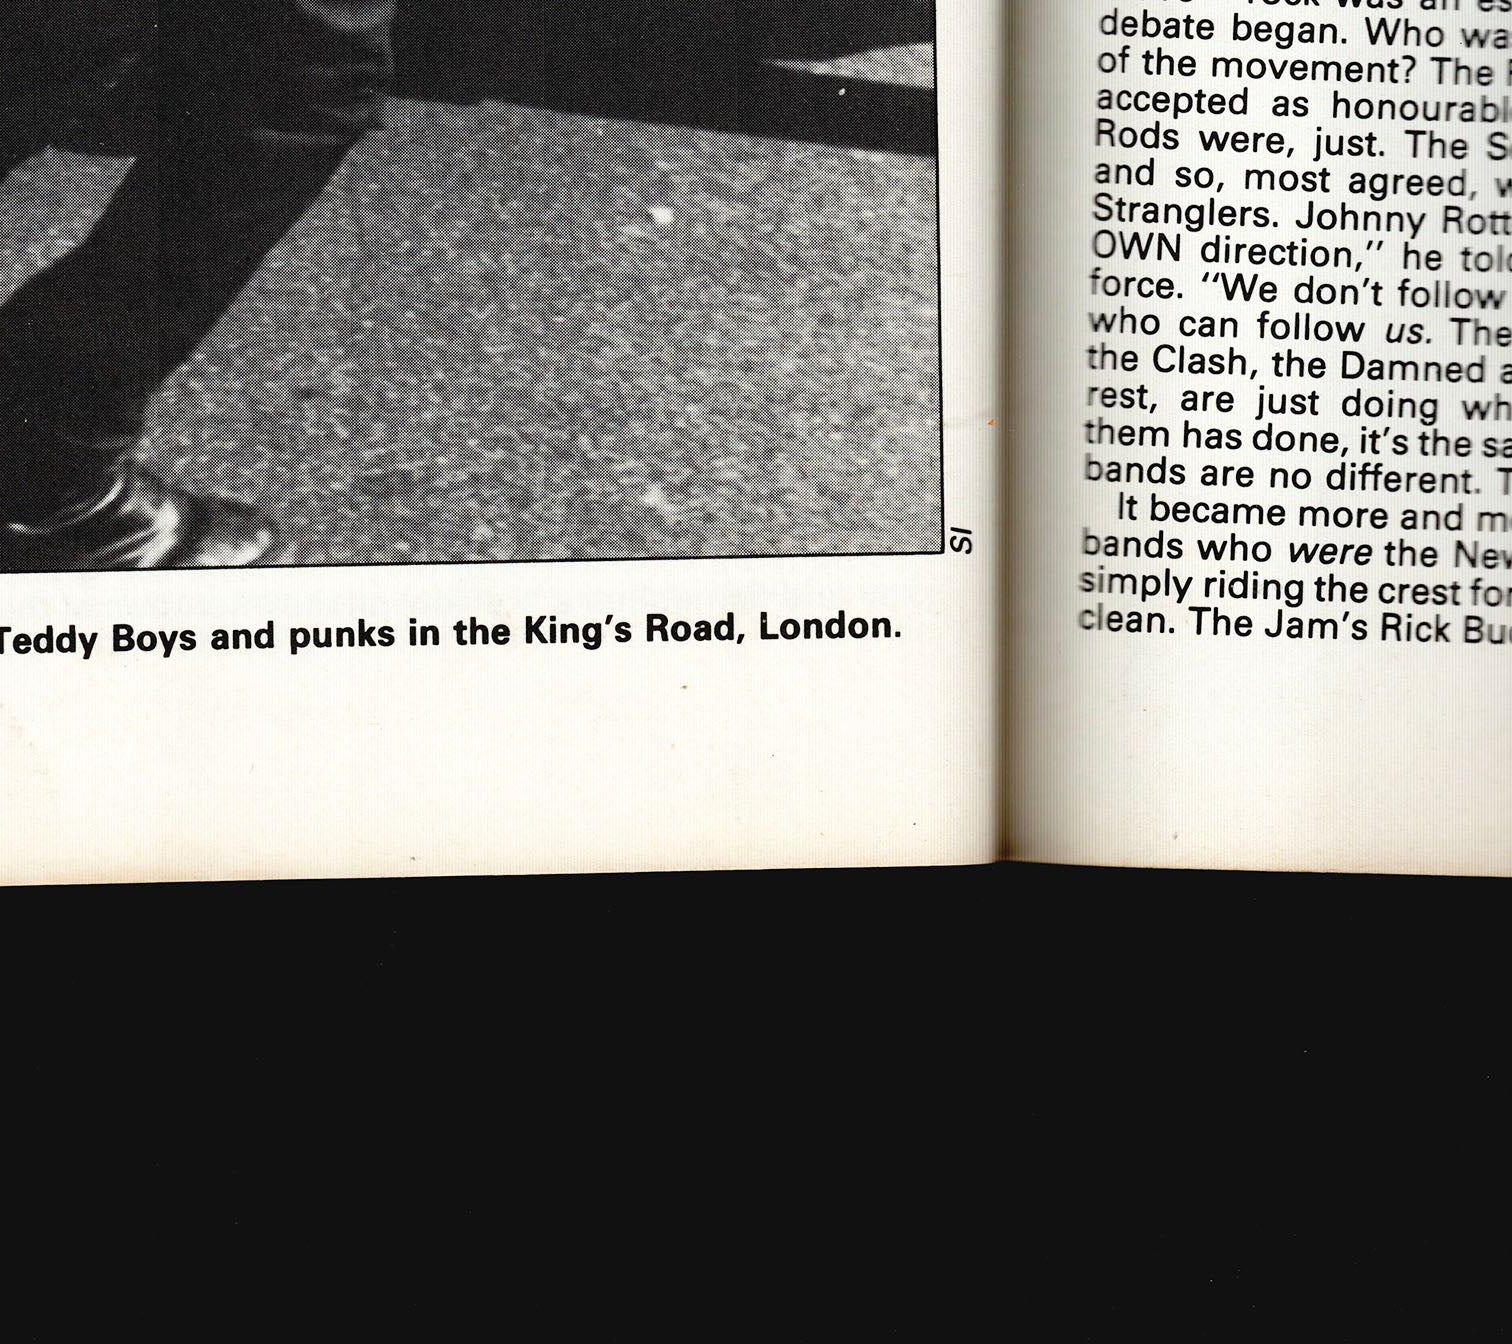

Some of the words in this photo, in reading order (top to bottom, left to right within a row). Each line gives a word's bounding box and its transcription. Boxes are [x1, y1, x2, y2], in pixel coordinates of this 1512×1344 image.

[1099, 7, 1215, 41] debate
[1232, 12, 1347, 50] began.
[1211, 54, 1417, 84] movement?
[1096, 86, 1249, 120] accepted
[1095, 117, 1180, 151] Rods
[1198, 130, 1295, 159] were,
[1312, 126, 1385, 163] just.
[1244, 167, 1331, 194] most
[1348, 168, 1477, 202] agreed,
[1092, 191, 1279, 233] Stranglers.
[1295, 200, 1427, 240] Johnny
[1088, 266, 1183, 300] force.
[1256, 310, 1366, 343] follow
[1152, 343, 1258, 381] Clash,
[1341, 350, 1486, 384] Damned
[1087, 384, 1158, 414] rest,
[1254, 384, 1320, 421] just
[1341, 387, 1438, 427] doing
[1084, 416, 1170, 448] them
[1252, 422, 1349, 458] done,
[1085, 453, 1186, 486] bands
[1325, 461, 1480, 495] different.
[1150, 492, 1286, 527] became
[1298, 505, 1389, 530] more
[1082, 527, 1184, 560] bands
[1289, 542, 1373, 566] were
[1079, 564, 1194, 605] simply
[1204, 569, 1304, 609] riding
[1377, 581, 1462, 607] crest
[112, 623, 197, 659] Boys
[210, 620, 275, 651] and
[290, 618, 395, 655] punks
[409, 617, 440, 647] in
[452, 616, 511, 646] the
[525, 614, 632, 651] King's
[646, 611, 745, 645] Road,
[760, 609, 903, 640] London.
[1078, 602, 1175, 634] clean.
